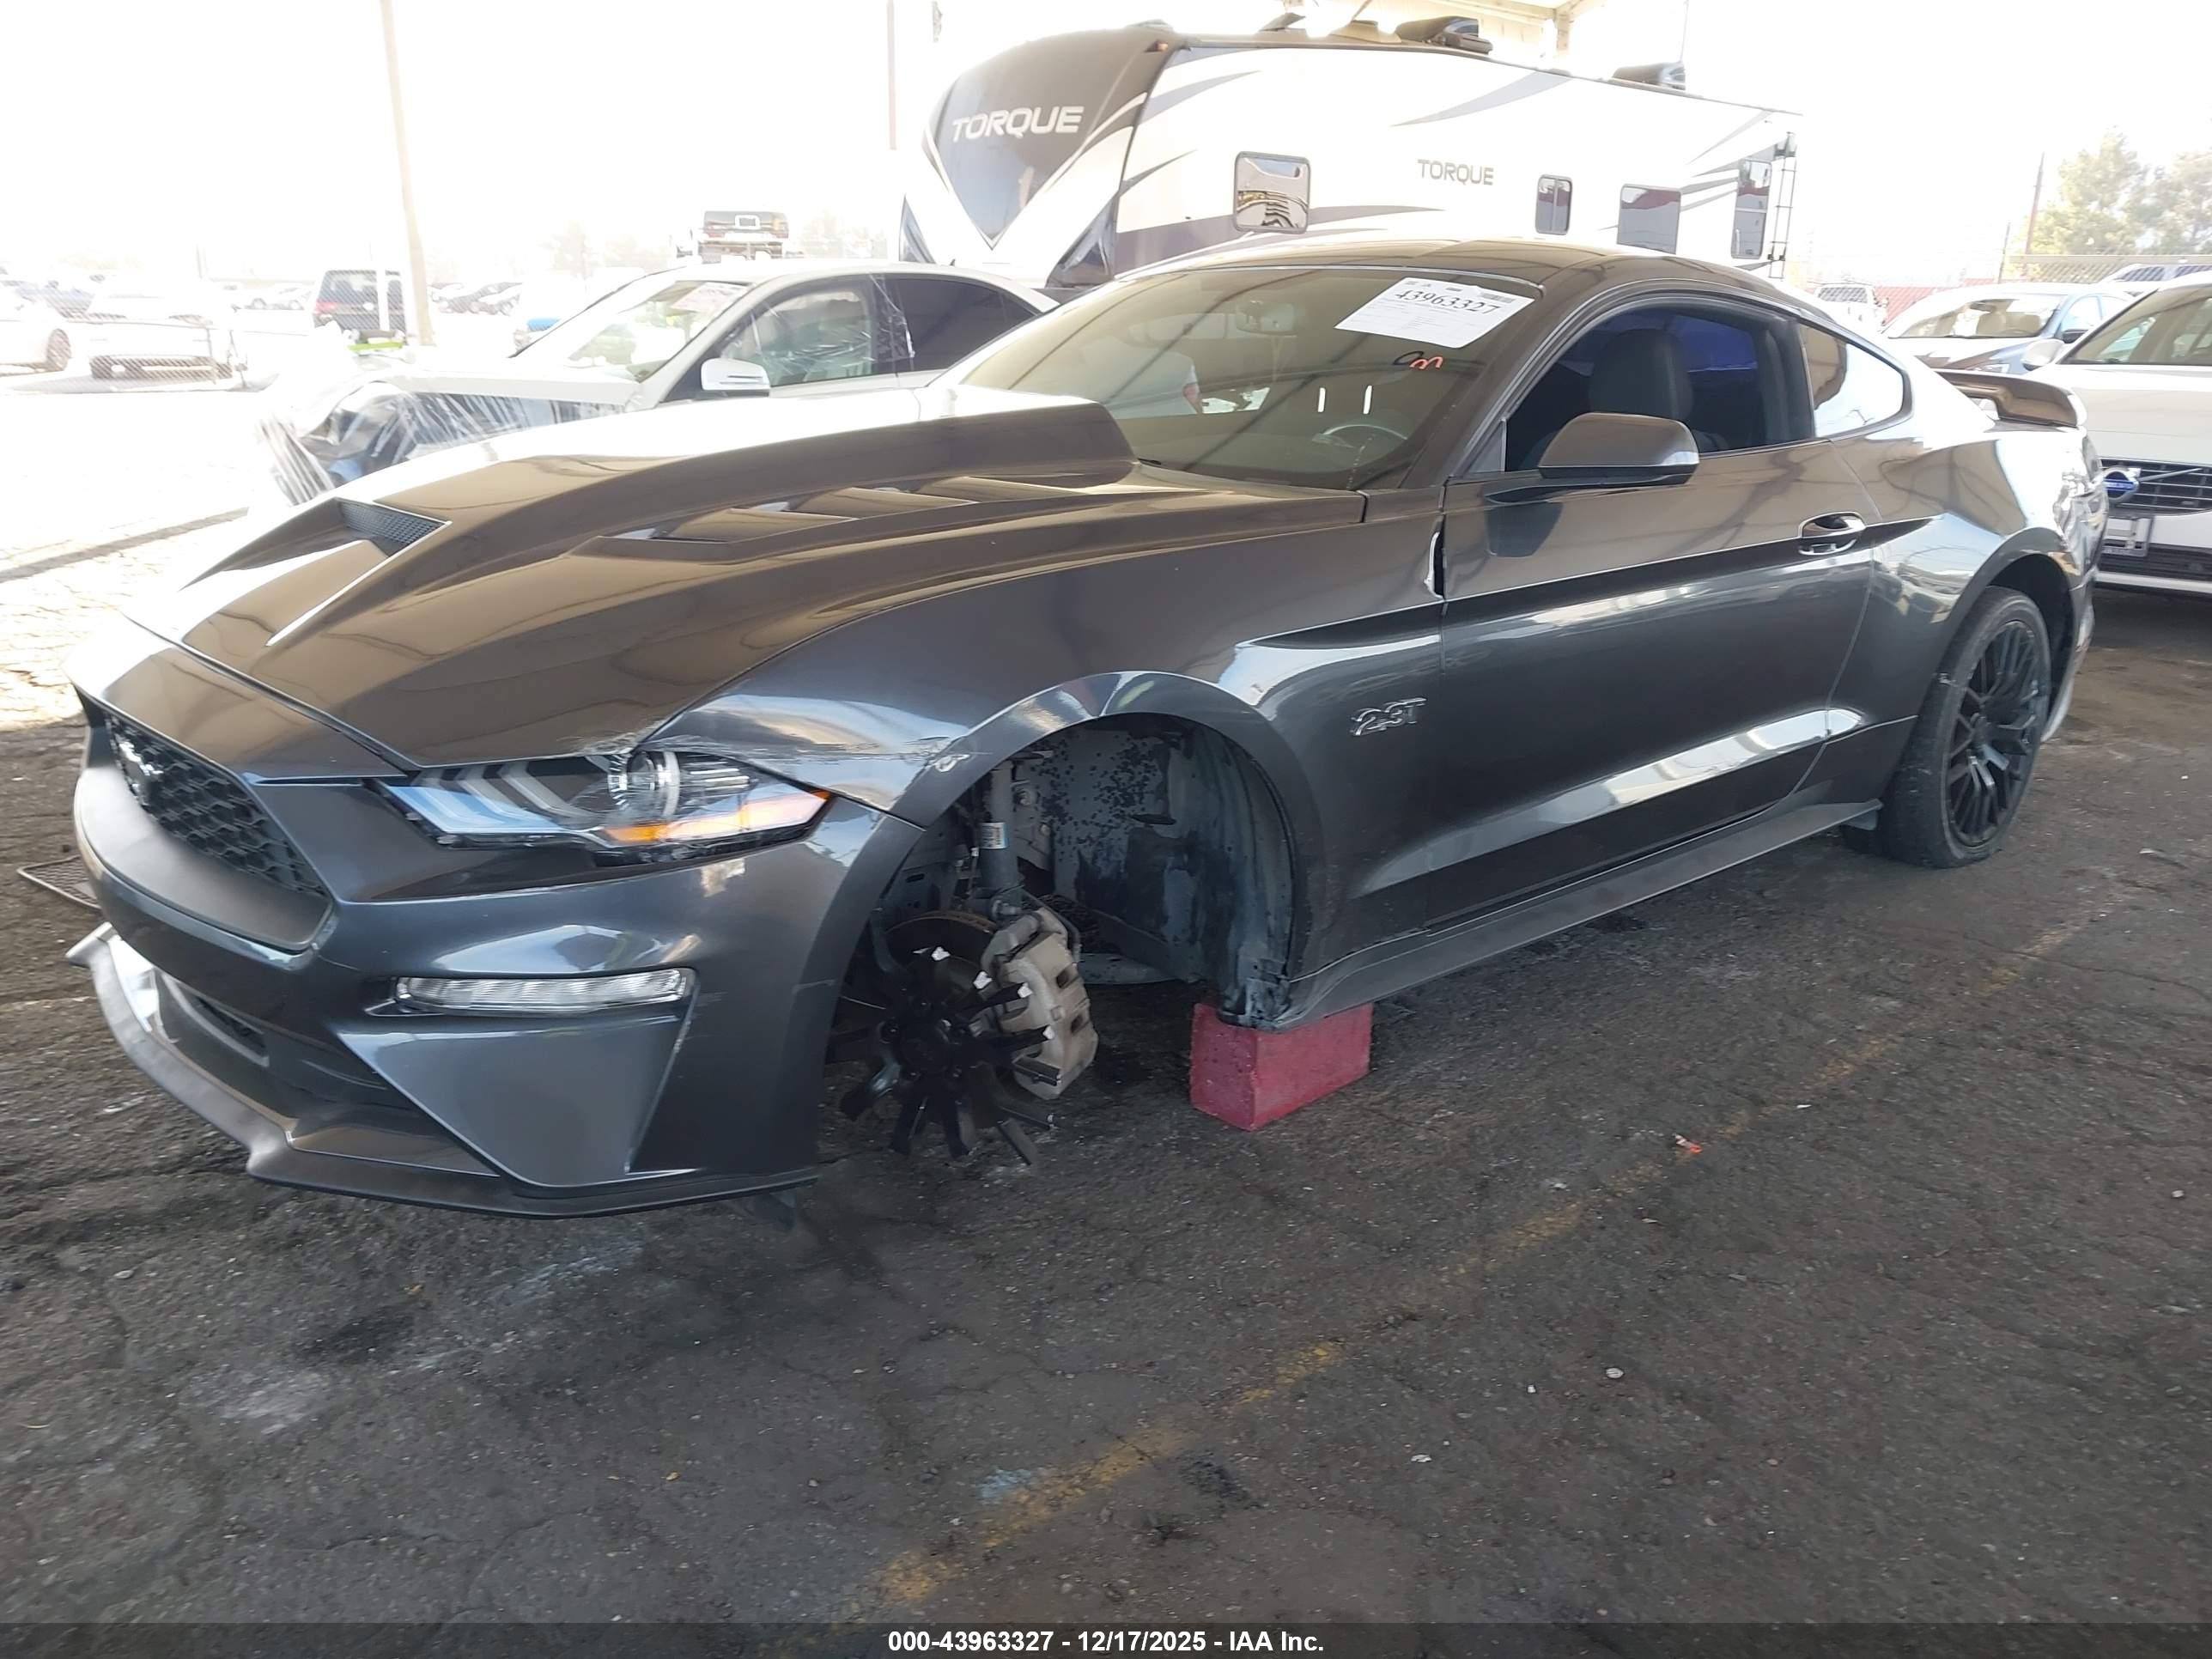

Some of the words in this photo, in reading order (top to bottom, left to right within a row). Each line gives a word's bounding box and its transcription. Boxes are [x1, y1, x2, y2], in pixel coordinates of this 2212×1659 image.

[951, 105, 1085, 143] TORQUE
[1417, 158, 1494, 186] TORQUE
[1395, 289, 1501, 314] 43963327
